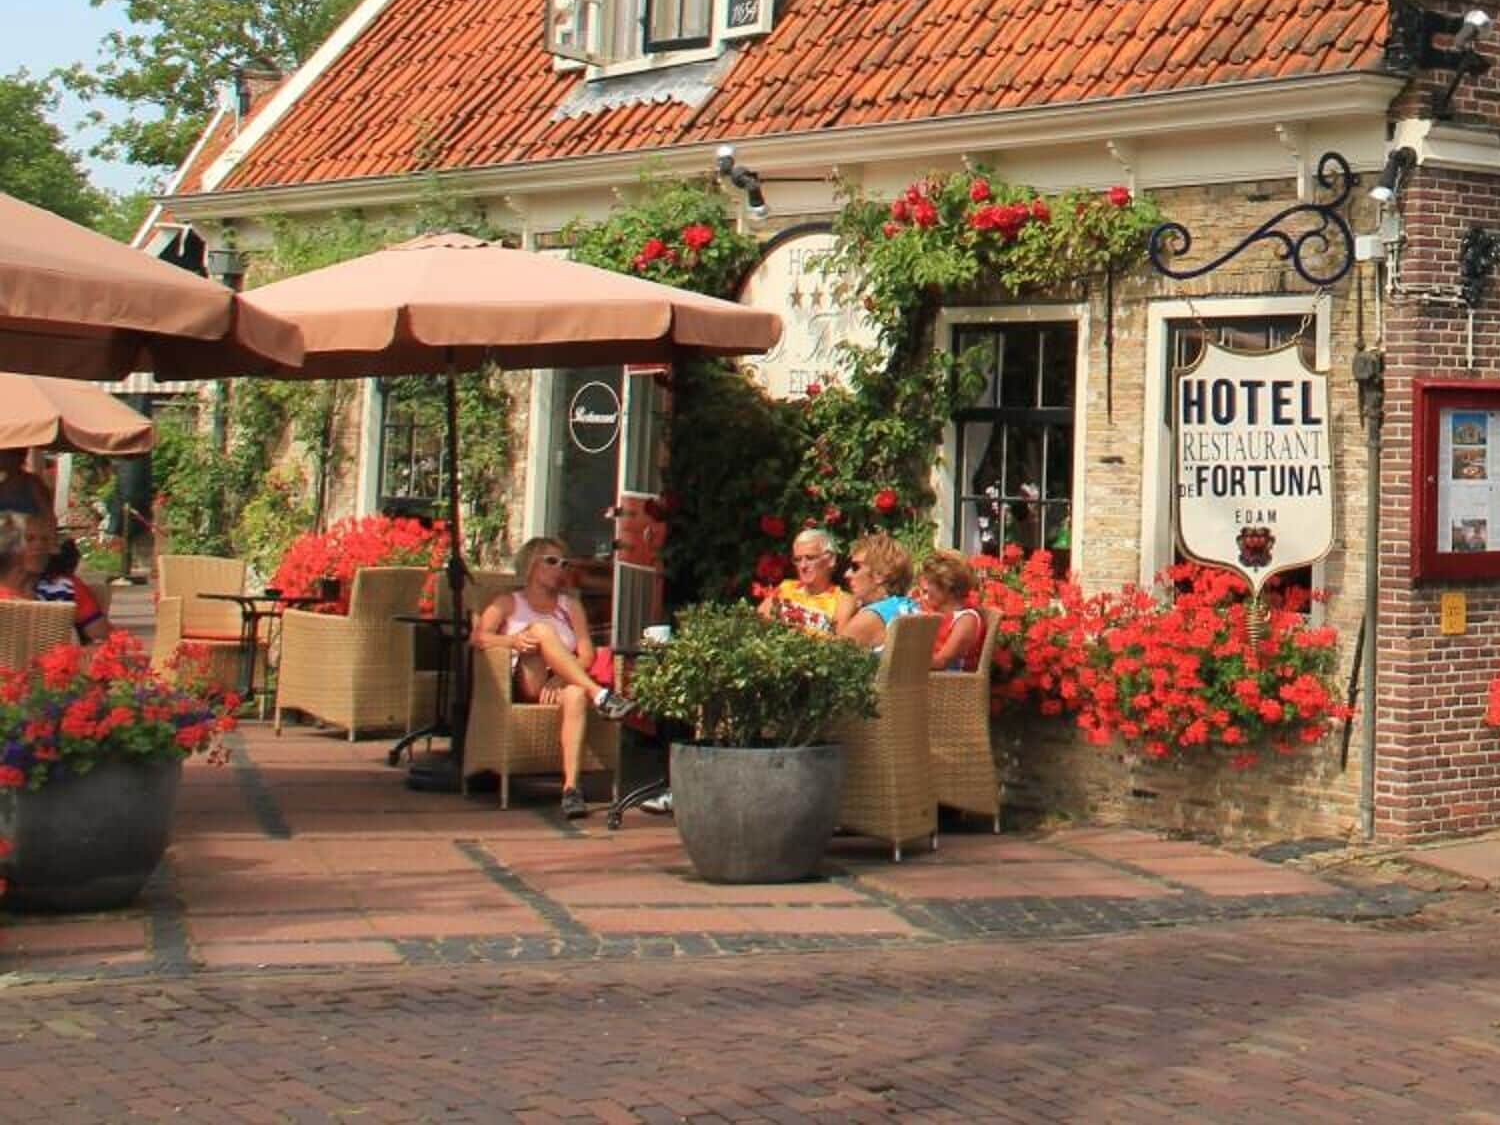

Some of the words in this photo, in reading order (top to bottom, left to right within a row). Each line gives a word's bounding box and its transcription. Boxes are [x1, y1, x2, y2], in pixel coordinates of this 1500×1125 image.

[1183, 379, 1322, 425] HOTEL
[1183, 431, 1323, 461] RESTAURANT
[1178, 484, 1196, 498] DE
[1234, 510, 1278, 524] EDAM
